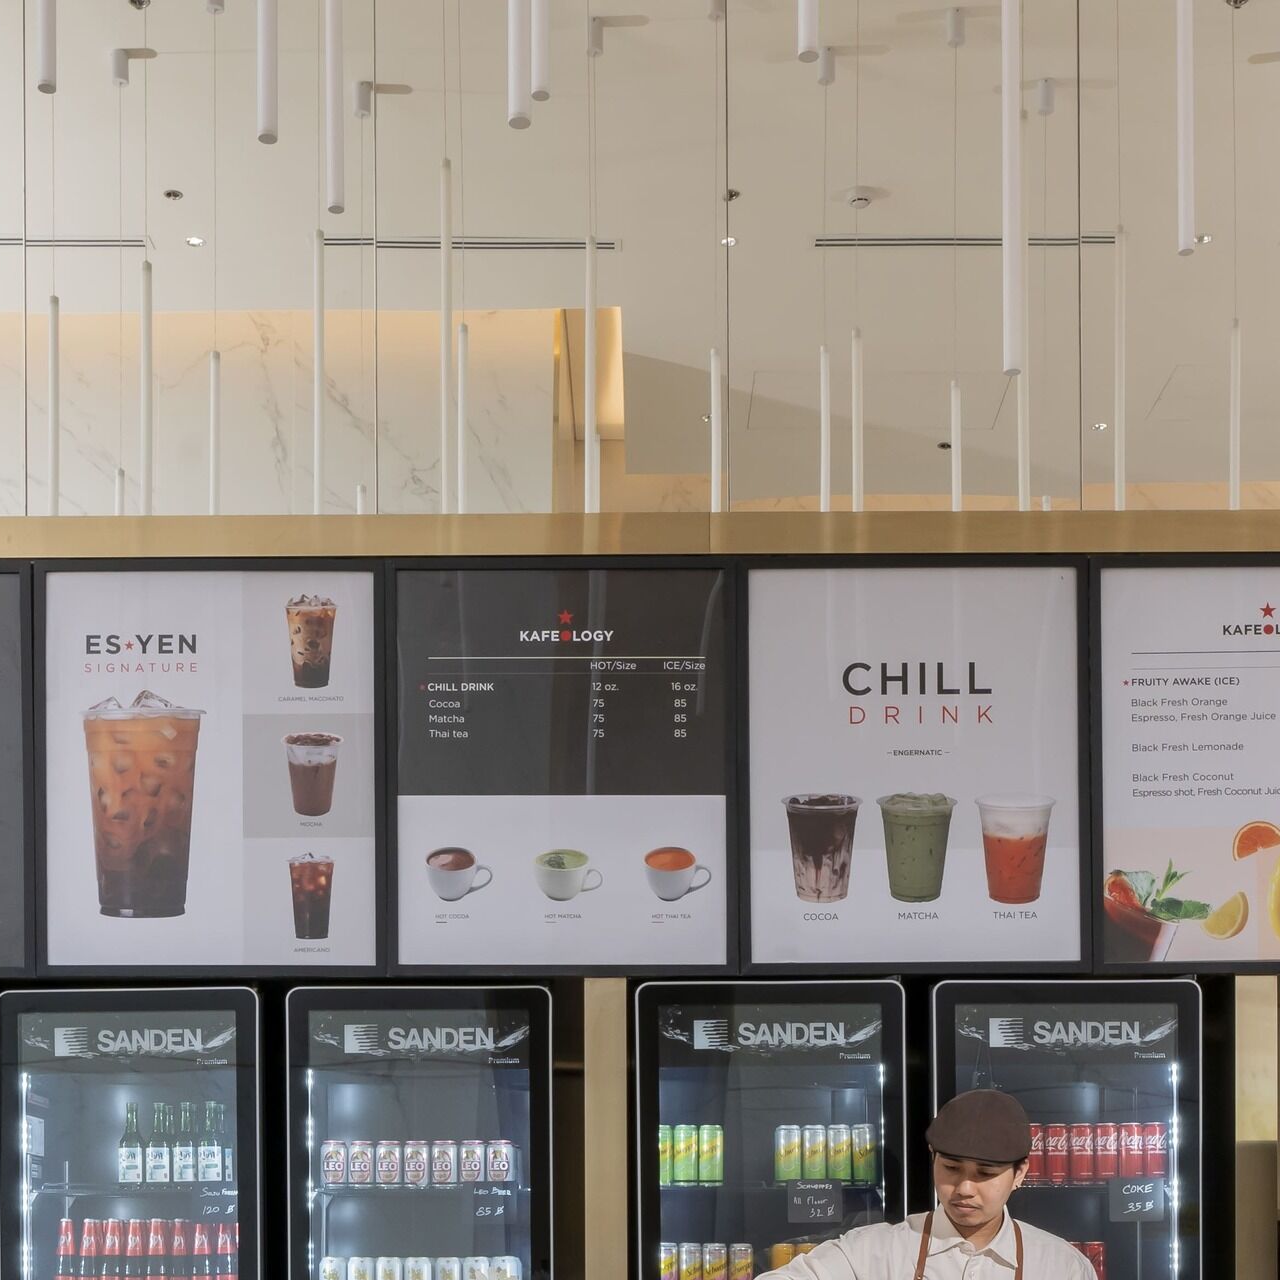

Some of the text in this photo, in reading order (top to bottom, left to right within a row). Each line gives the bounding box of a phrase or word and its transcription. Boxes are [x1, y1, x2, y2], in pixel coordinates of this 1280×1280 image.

[84, 663, 198, 673] SIGNATURE
[590, 661, 706, 671] HOT/Size ICE/Size
[842, 662, 992, 696] CHILL
[1131, 676, 1240, 687] FRUITY AWAKE (ICE)
[428, 683, 458, 691] CHILL
[461, 683, 494, 691] DRINK
[592, 682, 601, 691] 12
[671, 682, 681, 691] 16
[429, 699, 687, 708] Cocoa 75 85
[1131, 698, 1158, 707] Black
[1161, 698, 1188, 707] Fresh
[1191, 697, 1228, 709] Orange
[429, 714, 687, 723] Matcha 75 85
[850, 706, 993, 724] DRINK
[1131, 712, 1276, 723] Espresso, Fresh Orange Juice
[429, 729, 687, 738] Thai tea 75 85
[1131, 743, 1159, 752] Black
[1162, 743, 1189, 752] Fresh
[1192, 742, 1244, 752] Lemonade
[1132, 773, 1159, 783] Black
[1162, 772, 1189, 782] Fresh
[1192, 772, 1234, 781] Coconut
[1132, 788, 1172, 799] Espresso
[1174, 788, 1196, 798] shot,
[1198, 787, 1222, 797] Fresh
[1224, 787, 1262, 797] Coconut
[803, 912, 839, 922] COCOA
[898, 912, 939, 920] MATCHA
[993, 911, 1038, 920] THAI TEA
[738, 1022, 845, 1045] SANDEN
[1033, 1021, 1141, 1044] SANDEN
[98, 1029, 203, 1051] SANDEN
[388, 1027, 495, 1050] SANDEN
[324, 1162, 343, 1171] LEO
[351, 1162, 369, 1171] LEO
[1122, 1184, 1153, 1194] COKE
[203, 1206, 219, 1215] 120
[1123, 1202, 1141, 1213] 35
